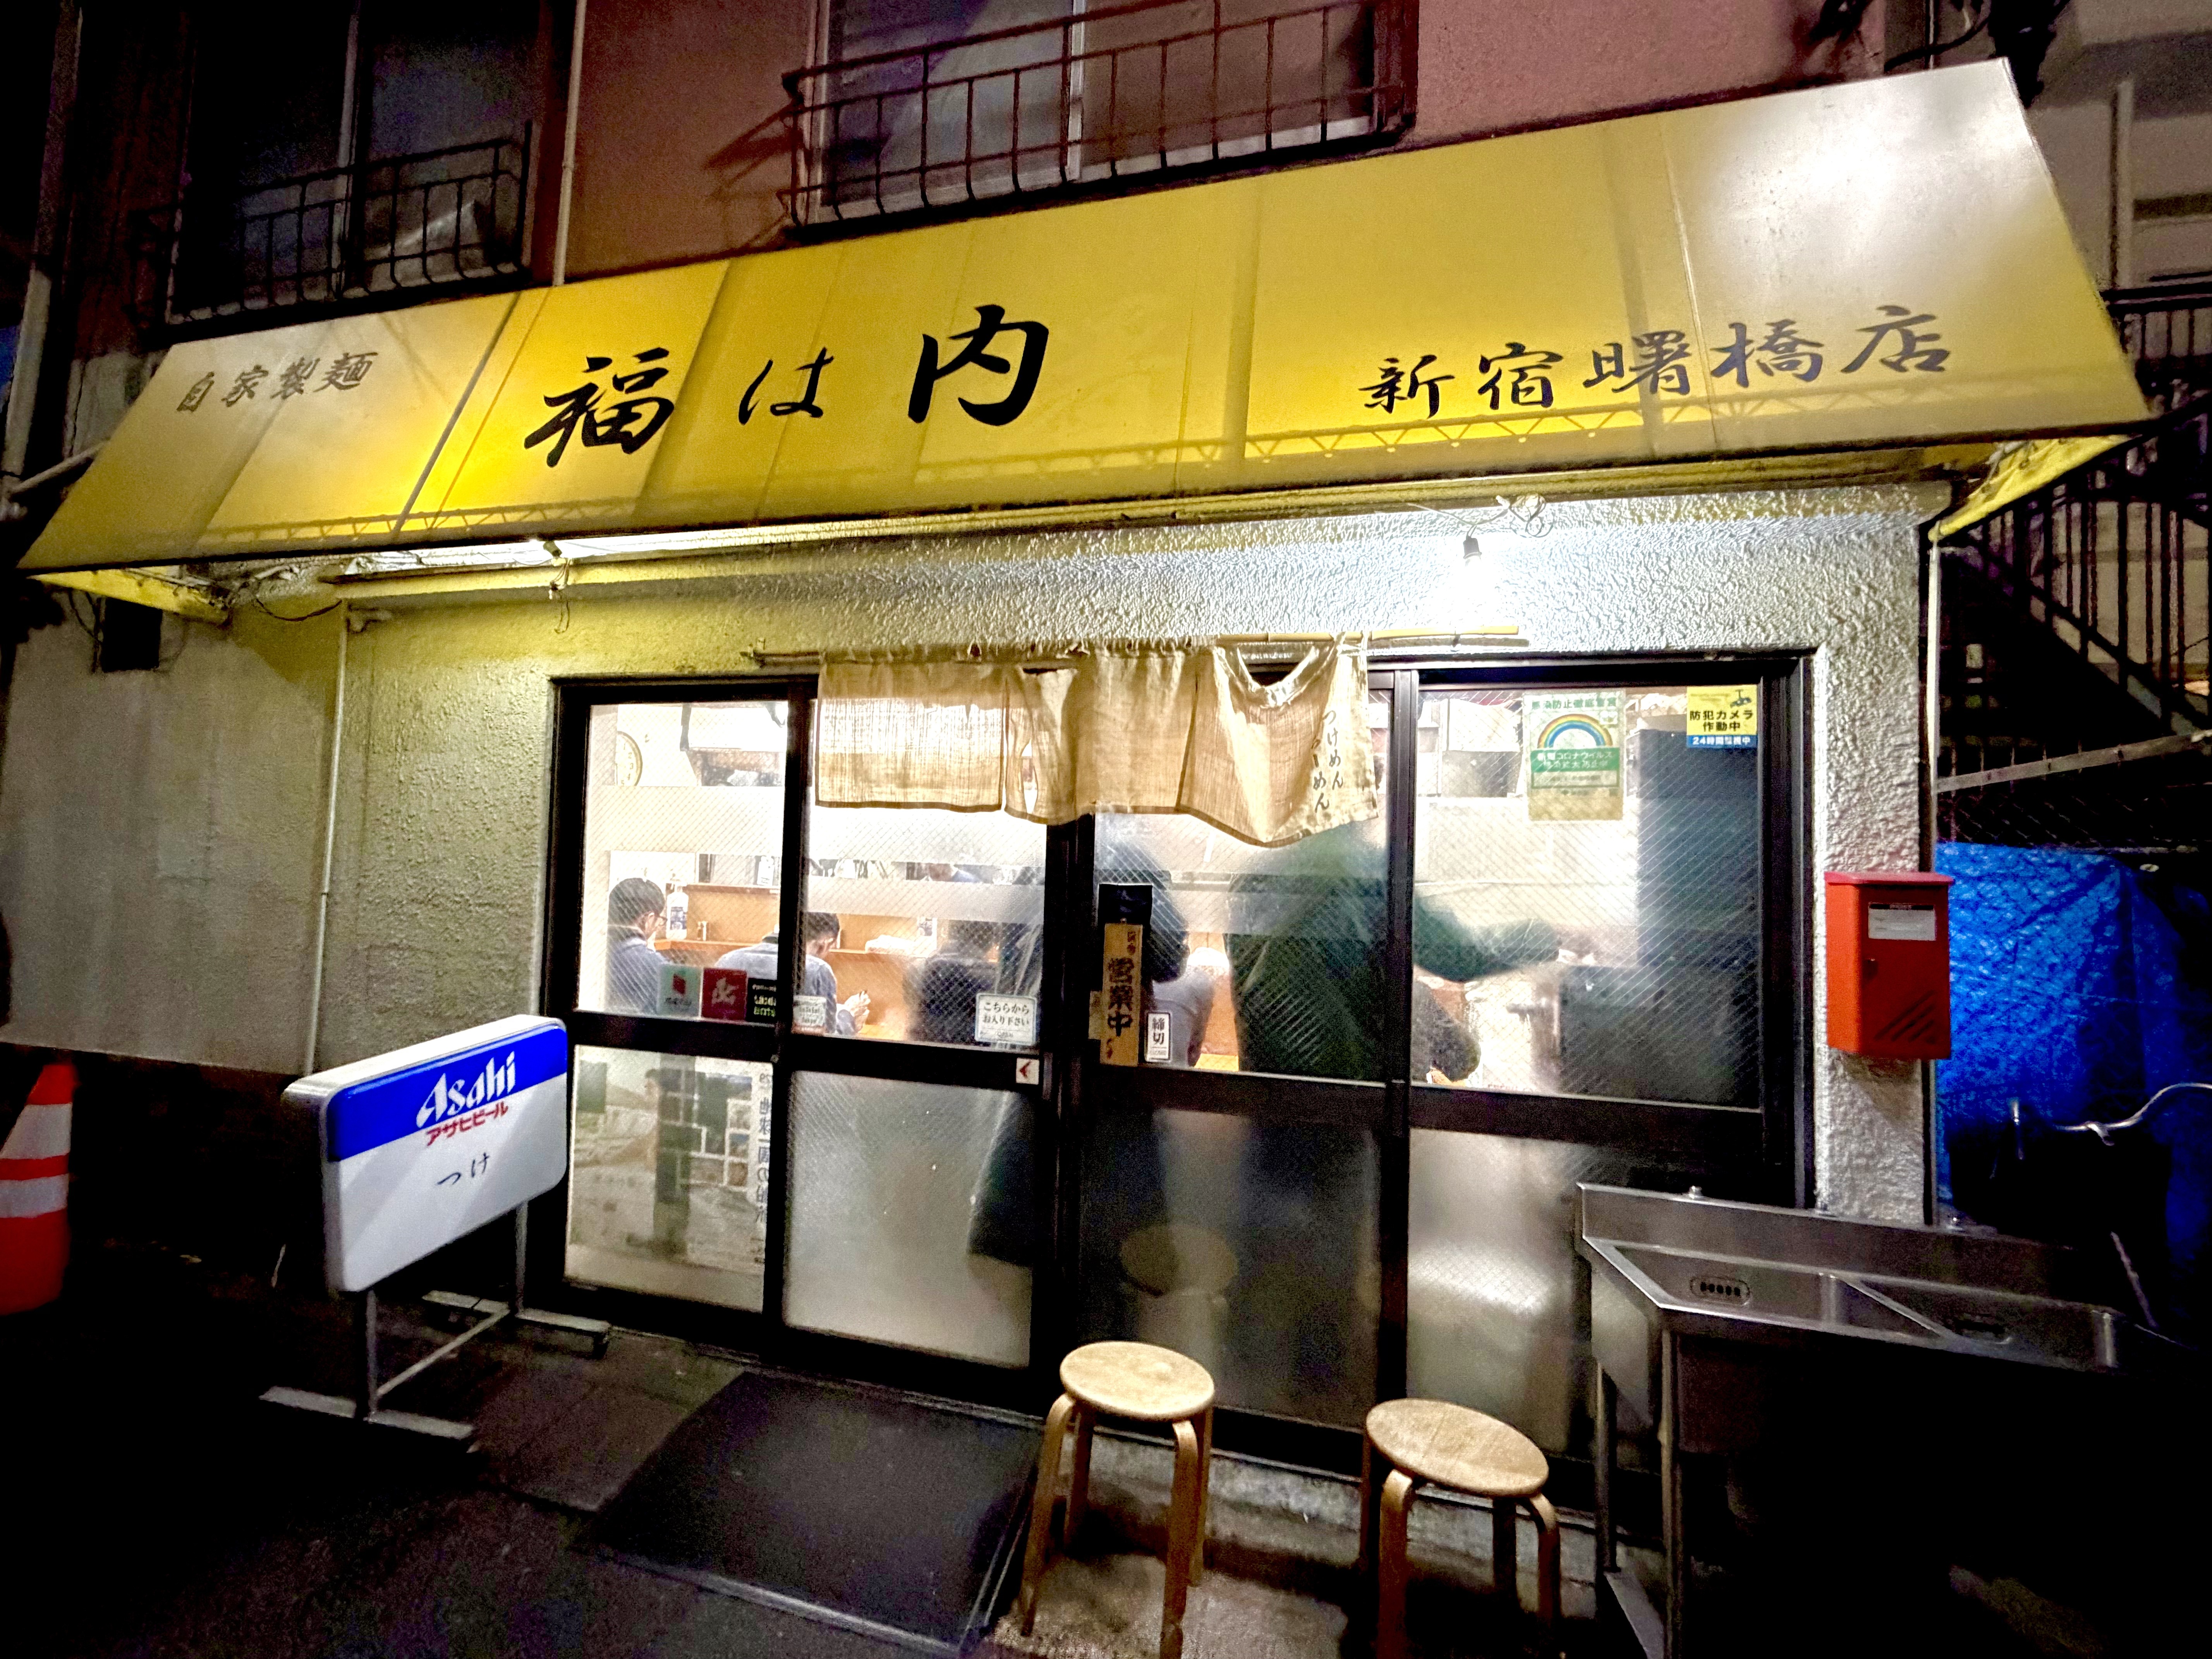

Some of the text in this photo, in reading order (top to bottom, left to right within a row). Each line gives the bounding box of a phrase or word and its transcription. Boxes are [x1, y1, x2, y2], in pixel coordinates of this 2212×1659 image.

[177, 352, 378, 412] 自家製麺
[1358, 305, 1950, 419] 新宿曙橋店
[526, 305, 1049, 467] 福は内
[1690, 709, 1753, 721] 防犯カメラ
[1703, 721, 1741, 732] 作動中
[1321, 710, 1343, 790] つけめん
[983, 1013, 1029, 1026] お入り下さい
[984, 1002, 1029, 1015] こちらから
[1151, 1017, 1165, 1045] 締切
[416, 1051, 516, 1128] Asahi
[426, 1101, 509, 1147] アサヒビール
